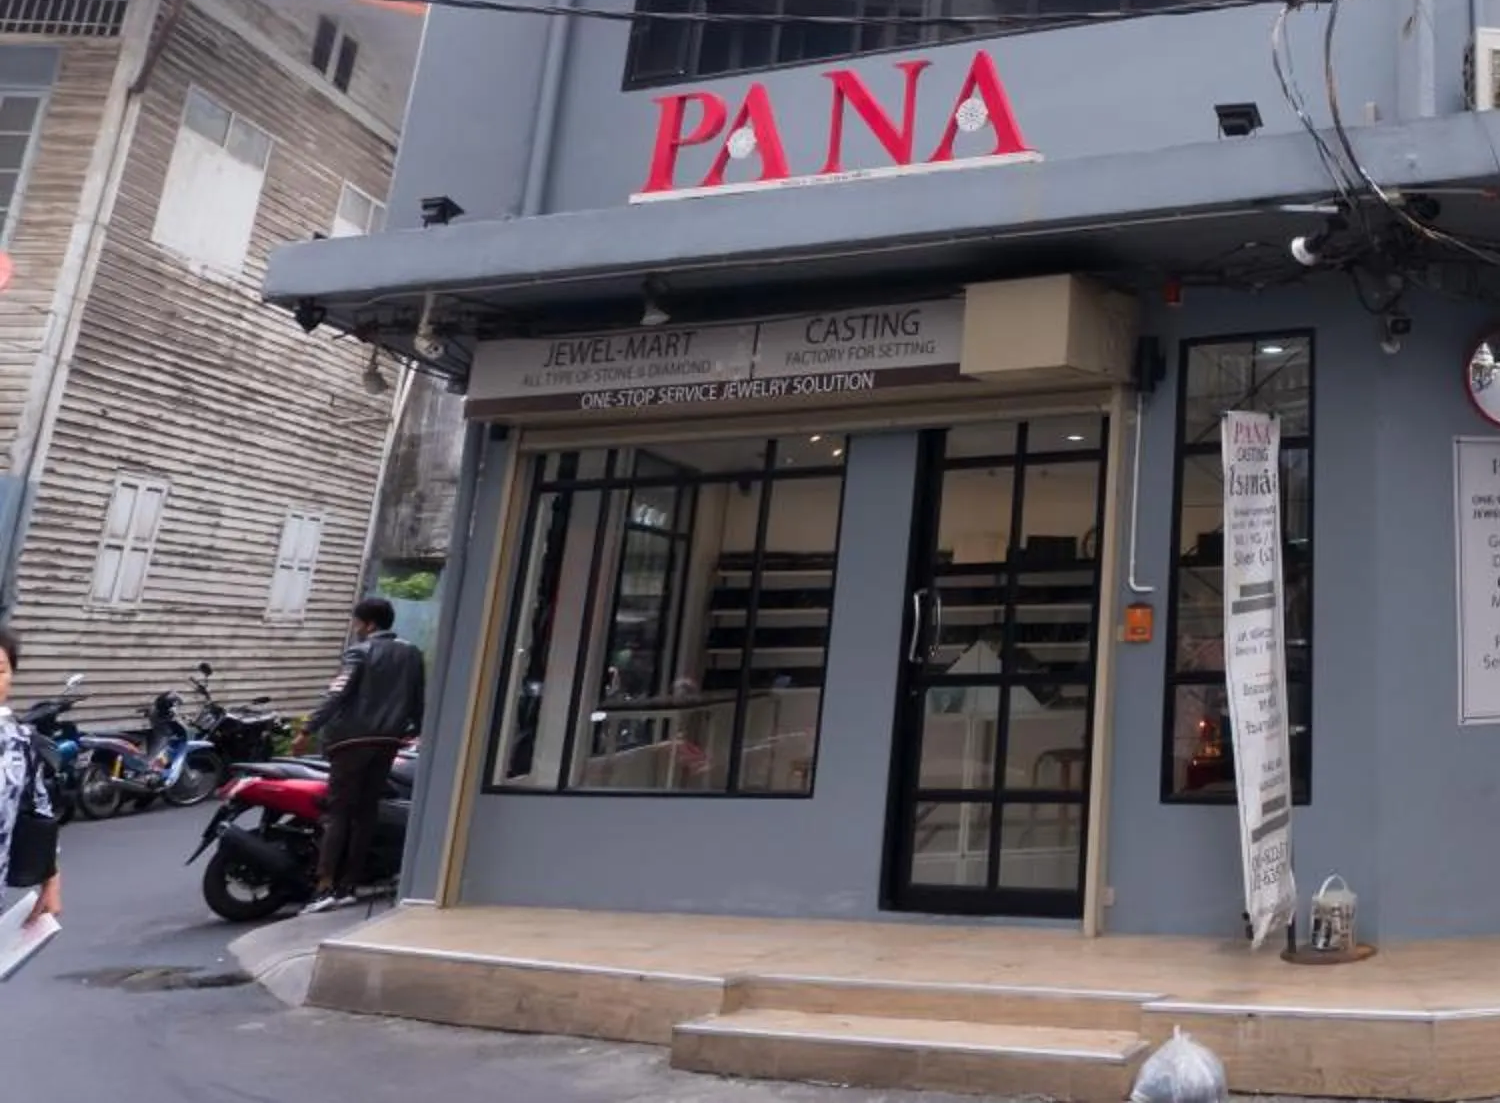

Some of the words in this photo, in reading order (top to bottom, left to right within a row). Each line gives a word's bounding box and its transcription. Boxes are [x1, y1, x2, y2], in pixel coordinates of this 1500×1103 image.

[641, 49, 1036, 194] PANA
[805, 308, 922, 345] CASTING
[543, 330, 697, 368] JEWEL-MART
[785, 347, 845, 366] FACTORY
[848, 345, 876, 361] FOR
[879, 340, 937, 358] SETTING
[647, 360, 712, 378] DIAMOND
[580, 390, 655, 410] ONE-STOP
[658, 384, 718, 404] SERVICE
[720, 378, 789, 400] JEWELRY
[792, 372, 876, 396] SOLUTION
